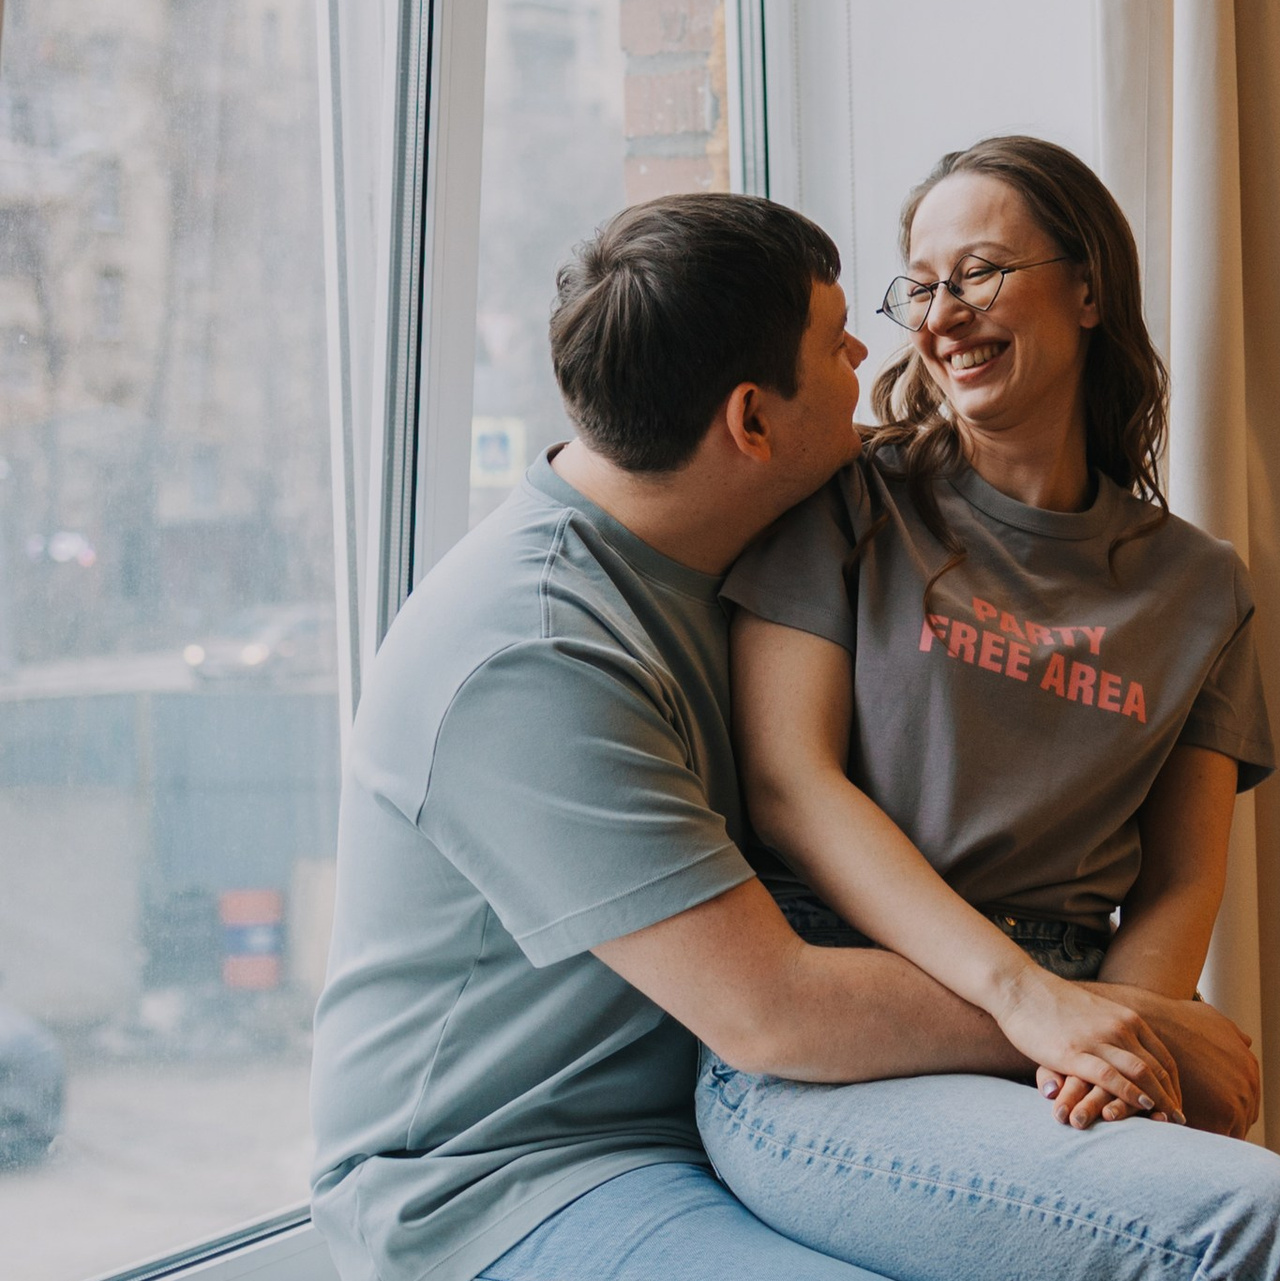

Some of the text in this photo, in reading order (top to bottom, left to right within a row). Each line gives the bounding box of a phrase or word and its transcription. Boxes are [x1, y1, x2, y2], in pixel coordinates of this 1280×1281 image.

[972, 597, 1107, 656] PARTY
[919, 614, 1146, 724] FREE AREA
